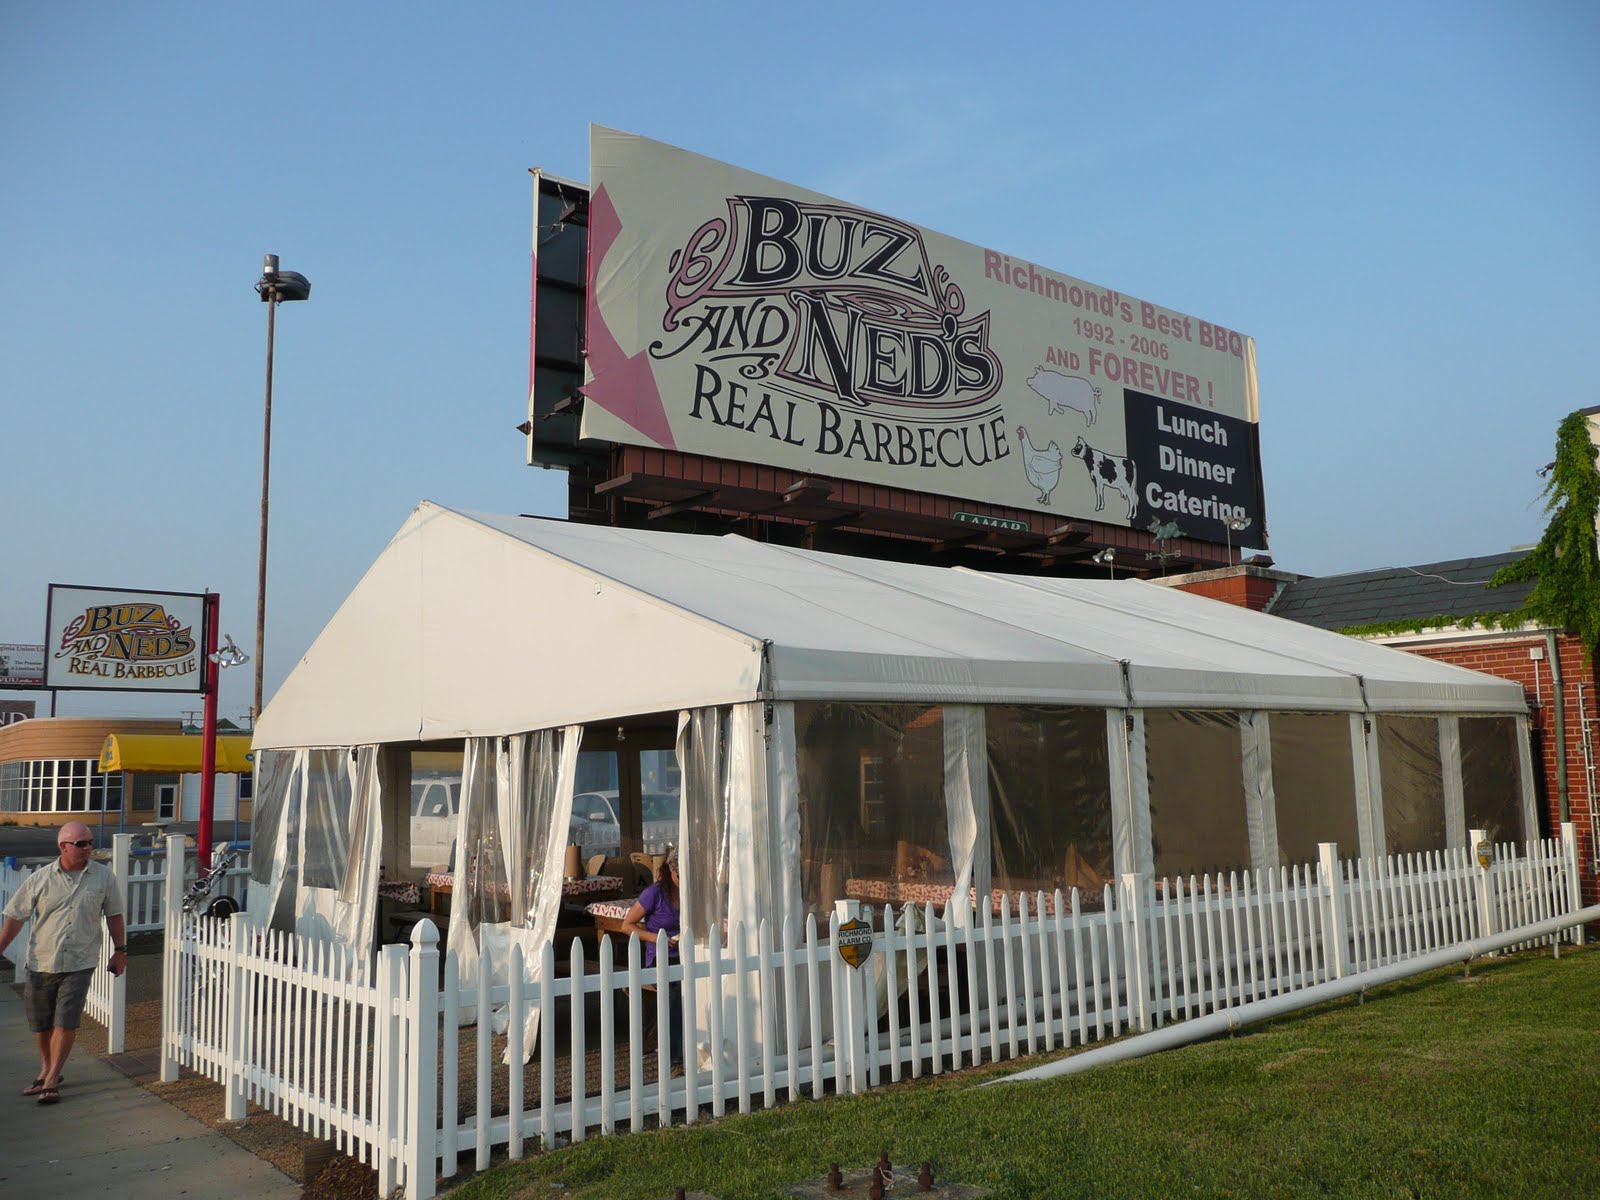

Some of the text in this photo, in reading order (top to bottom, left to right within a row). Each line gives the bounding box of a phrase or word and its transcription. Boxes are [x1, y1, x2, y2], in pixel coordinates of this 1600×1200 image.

[725, 195, 928, 294] BUZ
[984, 248, 1244, 361] Richmond's Best BBQ
[649, 290, 995, 406] AND NED'S
[1073, 317, 1115, 345] 1992
[1130, 334, 1169, 361] 2006
[1045, 346, 1080, 371] AND
[1088, 347, 1201, 404] FOREVER
[688, 363, 1011, 467] REAL BARBECUE
[1156, 406, 1228, 447] Lunch
[1159, 445, 1235, 485] Dinner
[1145, 482, 1247, 521] Catering
[89, 605, 165, 634] BUZ
[56, 629, 192, 662] AND NED'S
[68, 656, 197, 679] REAL BARBECUE
[838, 928, 872, 938] RICHMOND
[838, 937, 861, 946] ALARM
